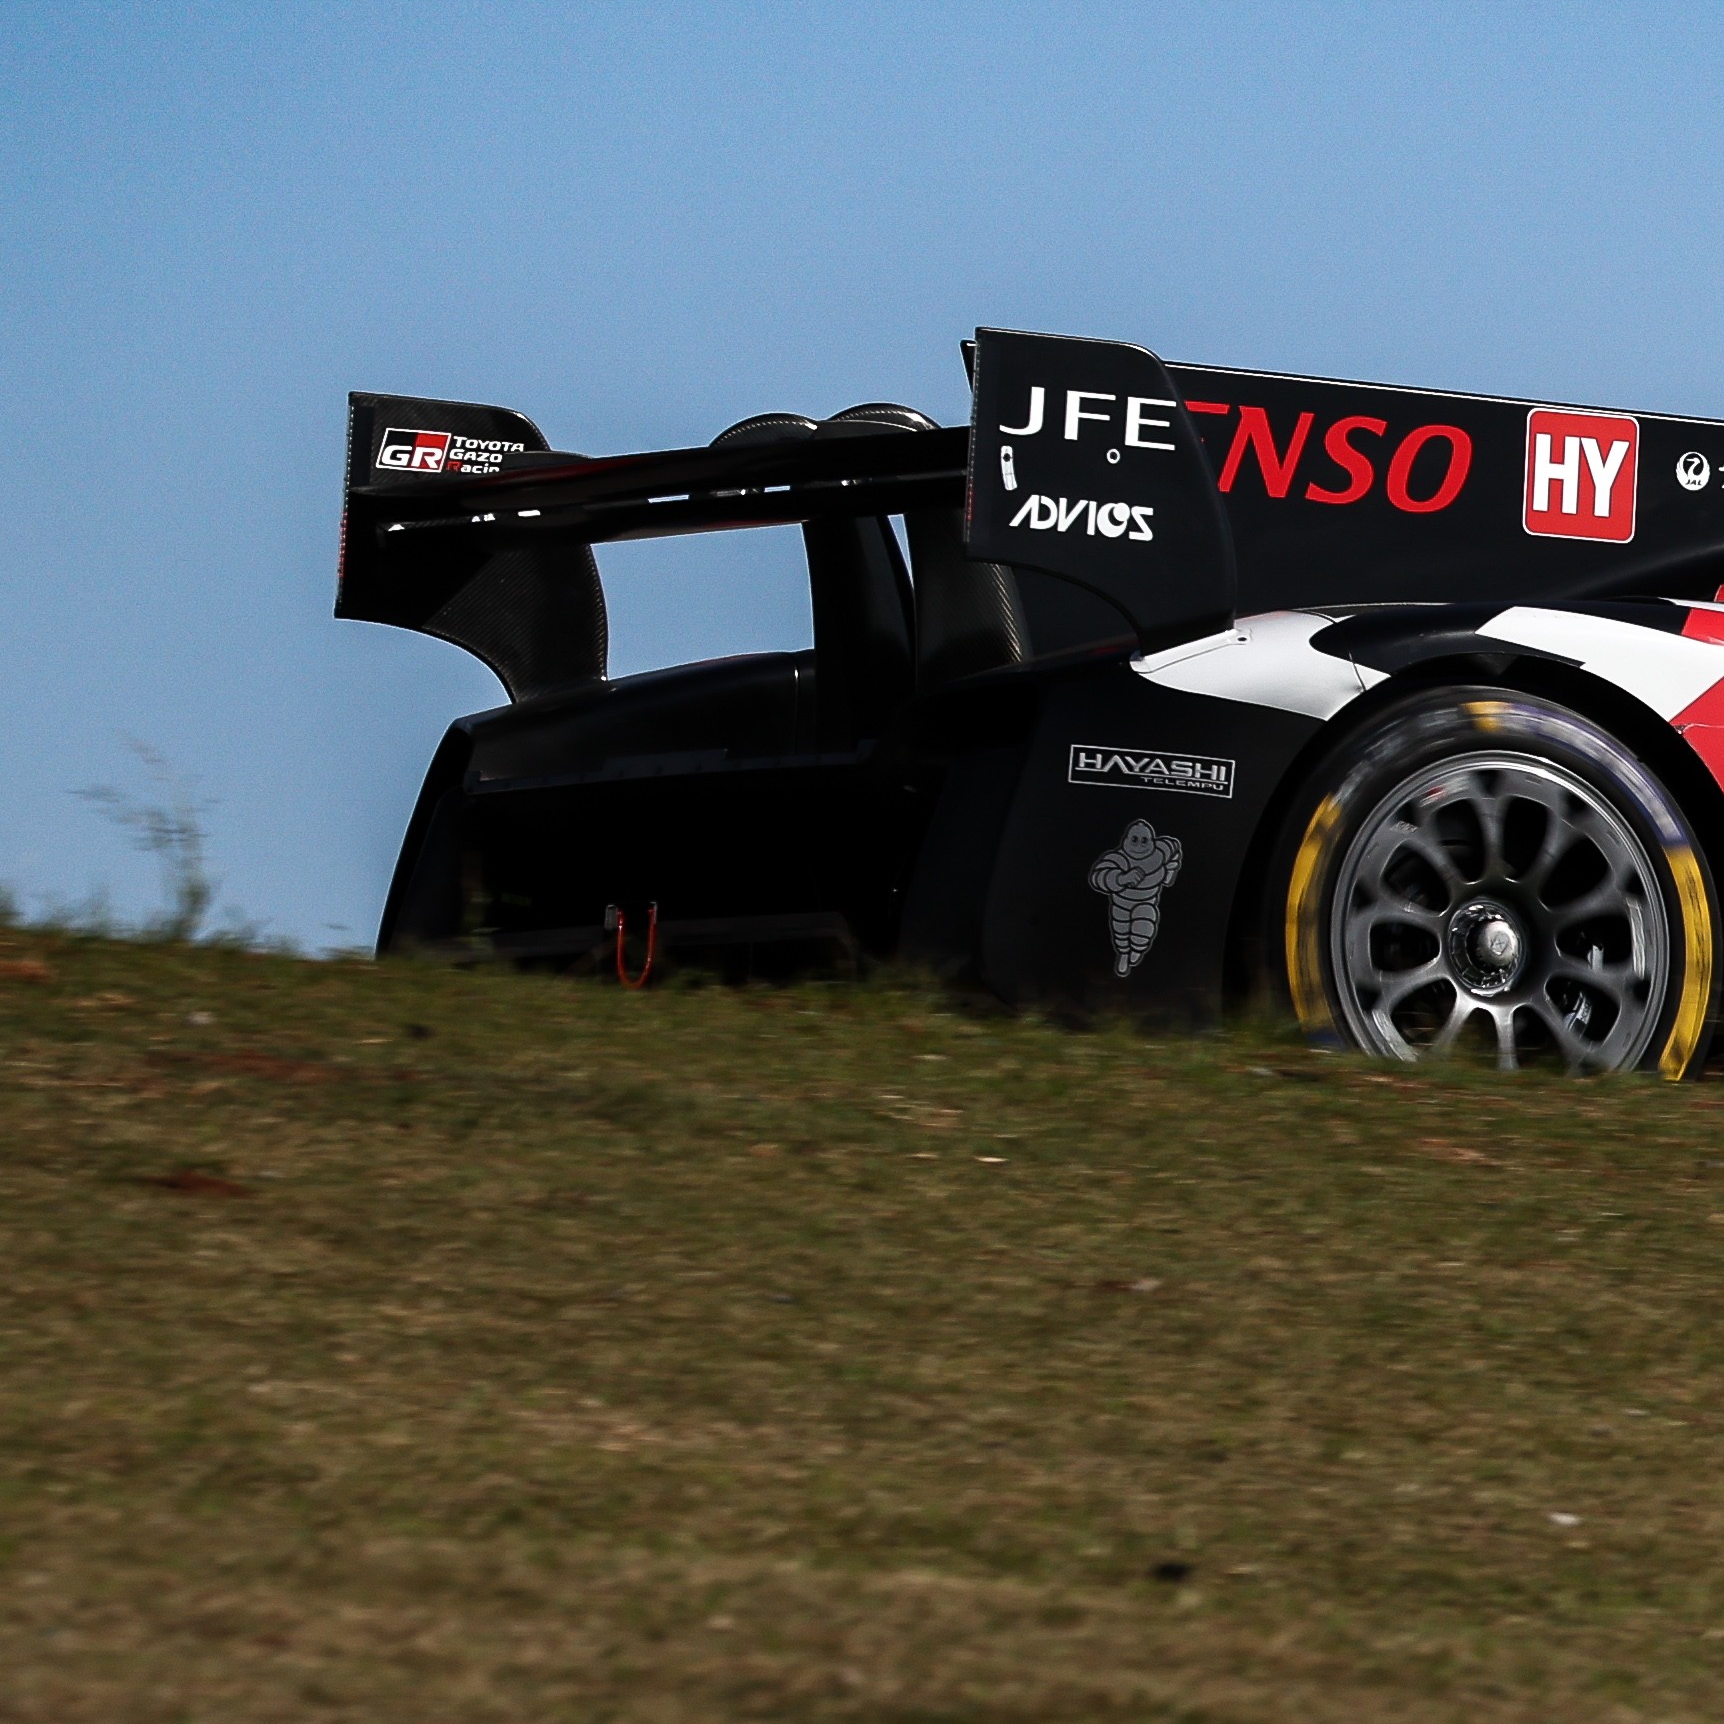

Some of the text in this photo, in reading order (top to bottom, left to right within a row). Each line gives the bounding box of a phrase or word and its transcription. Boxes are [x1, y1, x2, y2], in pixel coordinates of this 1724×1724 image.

[999, 386, 1177, 451] JFE
[381, 444, 443, 469] GR
[449, 449, 503, 463] GAZO
[453, 435, 525, 452] TOYOTA
[1184, 399, 1474, 514] NSO
[445, 461, 500, 474] Racin
[1532, 432, 1630, 518] HY
[1008, 494, 1154, 542] ADVICS
[1078, 752, 1227, 782] HAYASHI
[1140, 776, 1224, 791] TELEMPU
